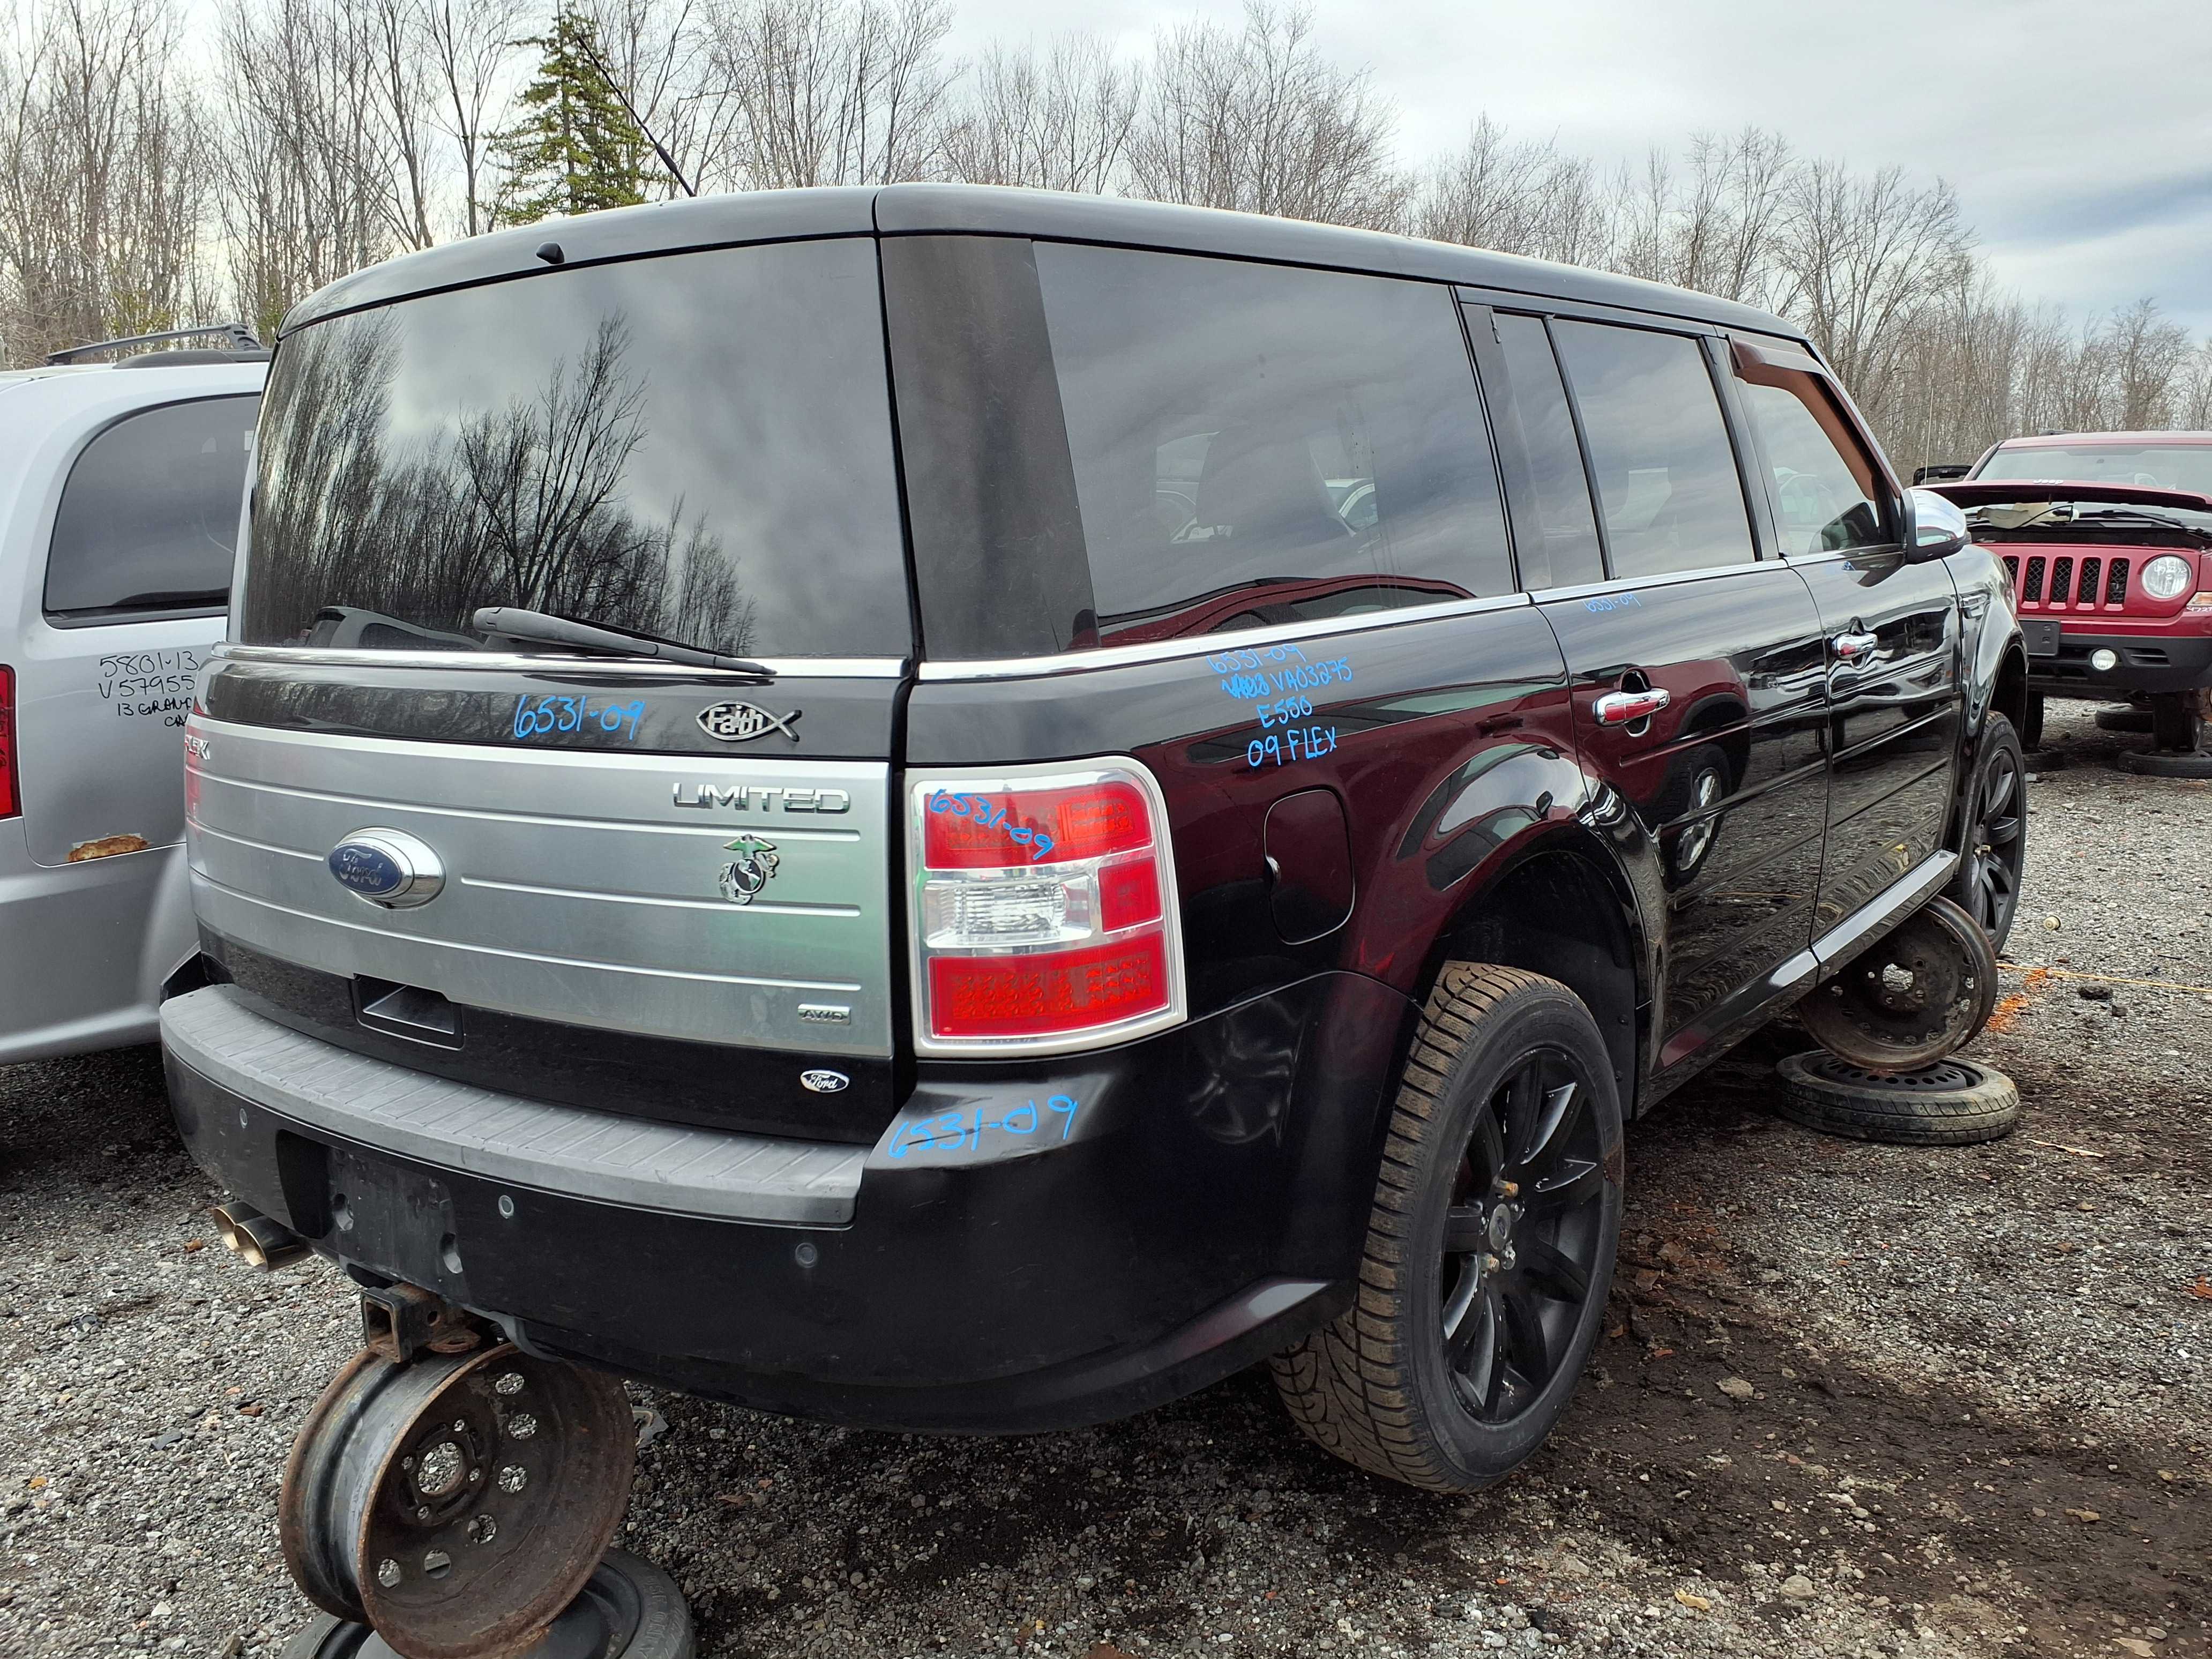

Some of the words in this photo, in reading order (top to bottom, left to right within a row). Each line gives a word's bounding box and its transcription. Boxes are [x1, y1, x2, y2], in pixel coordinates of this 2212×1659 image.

[100, 651, 199, 677] 5801-13
[1206, 644, 1306, 674] 6531-09
[1269, 656, 1352, 691] VA03275
[117, 703, 134, 716] 13
[514, 695, 646, 740] 6531-09
[707, 705, 764, 735] Faith
[1248, 735, 1281, 766] 09
[1287, 726, 1337, 761] FLEX
[672, 783, 851, 814] LIMITED
[929, 788, 1055, 860] 6531-09
[339, 848, 384, 886] Ford
[802, 1010, 844, 1022] AWD
[809, 1073, 838, 1089] Ford
[887, 1094, 1079, 1158] 6531-09
